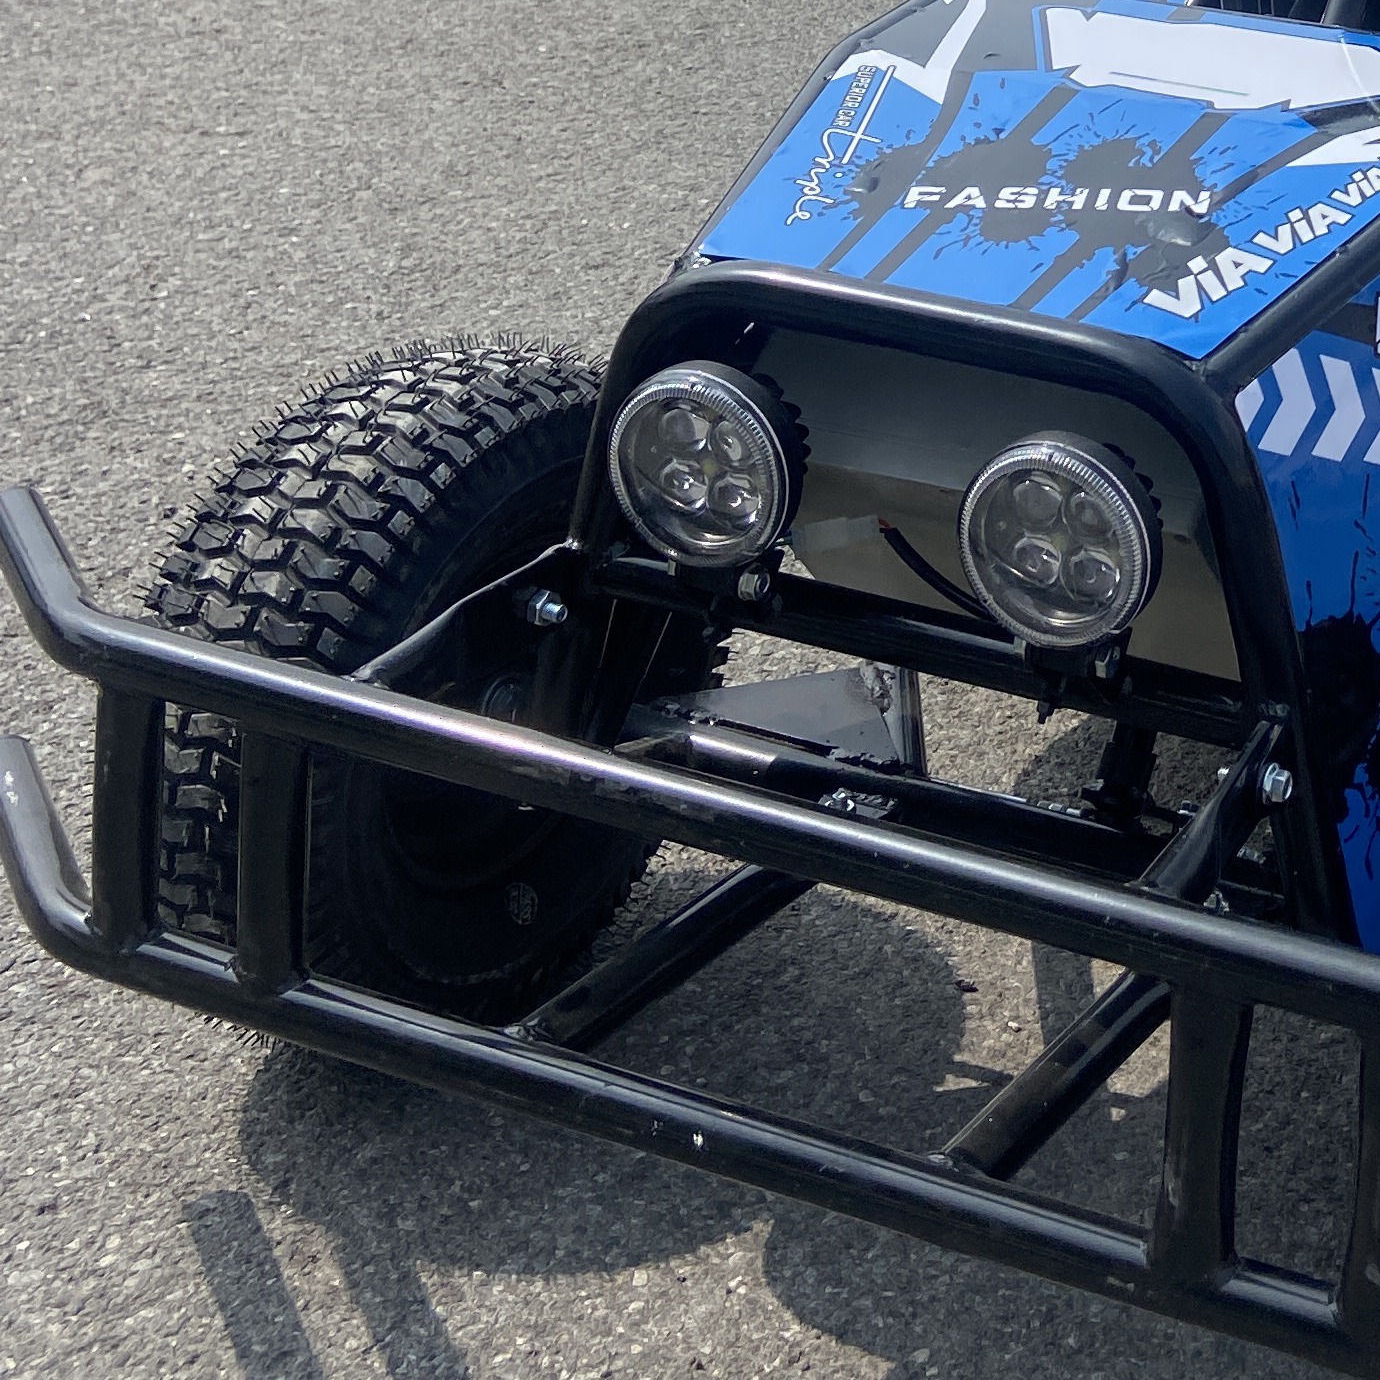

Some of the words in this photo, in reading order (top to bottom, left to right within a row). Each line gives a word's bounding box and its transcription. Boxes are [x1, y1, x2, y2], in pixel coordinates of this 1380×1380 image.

[841, 65, 878, 109] SUPERIOR
[832, 108, 857, 128] CAR
[903, 185, 1211, 215] FASHION
